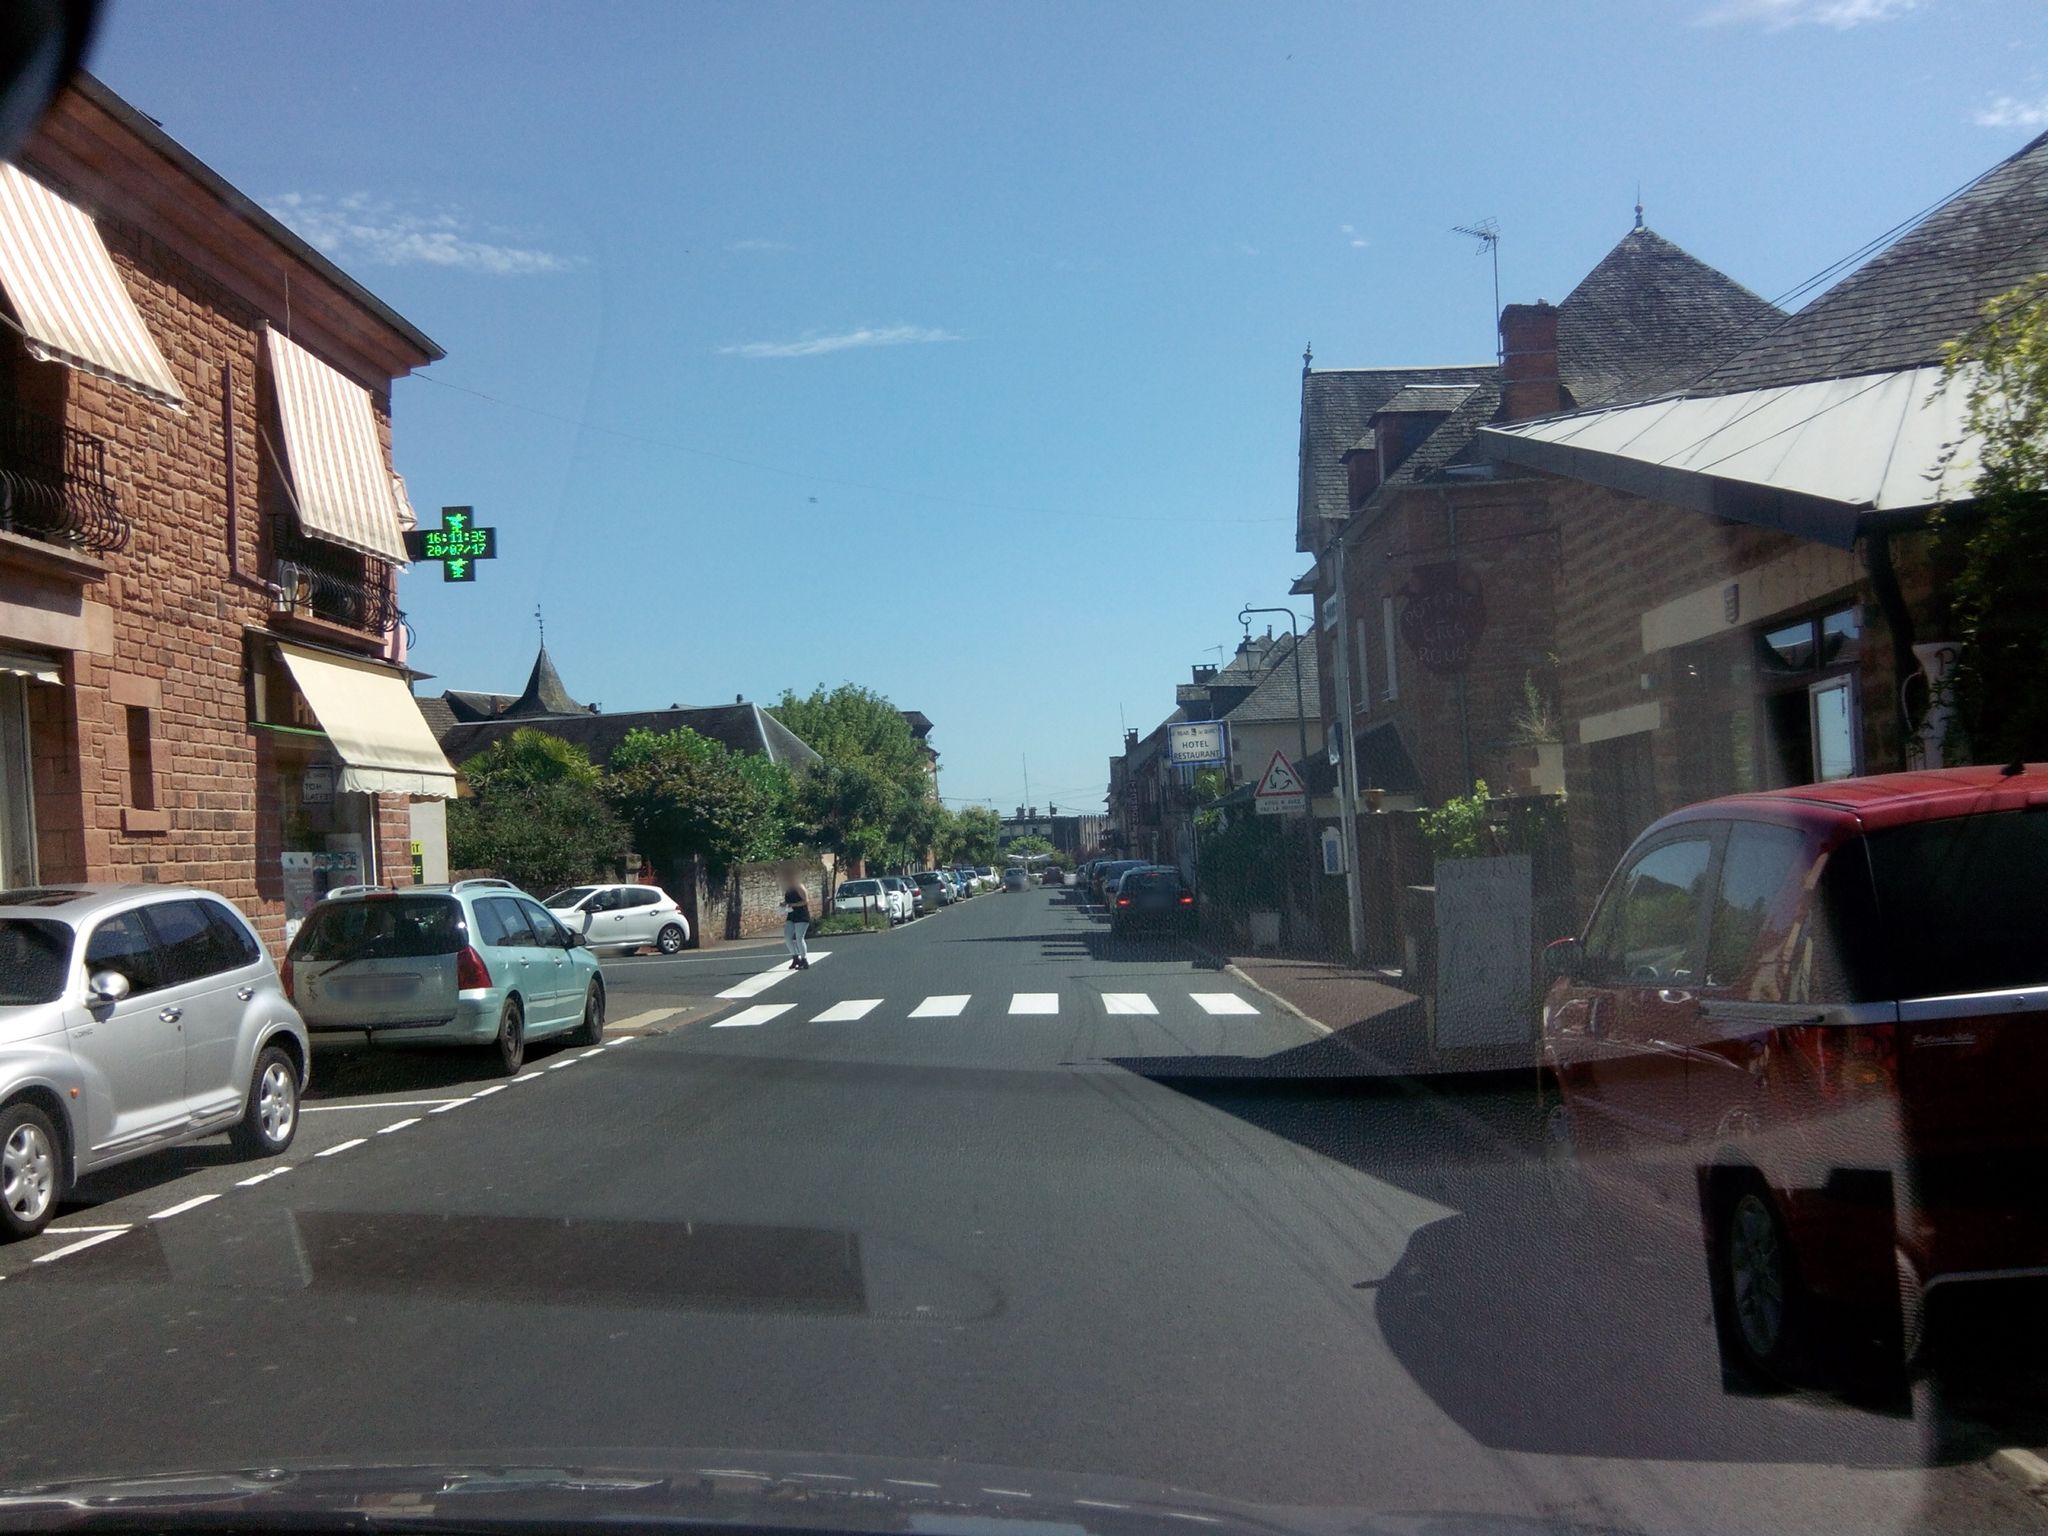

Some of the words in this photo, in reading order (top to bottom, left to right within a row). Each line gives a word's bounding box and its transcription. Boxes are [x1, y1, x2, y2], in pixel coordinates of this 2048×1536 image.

[426, 530, 486, 544] 16:11:35
[1182, 740, 1209, 749] HOTEL
[1173, 750, 1220, 760] RESTAURANT
